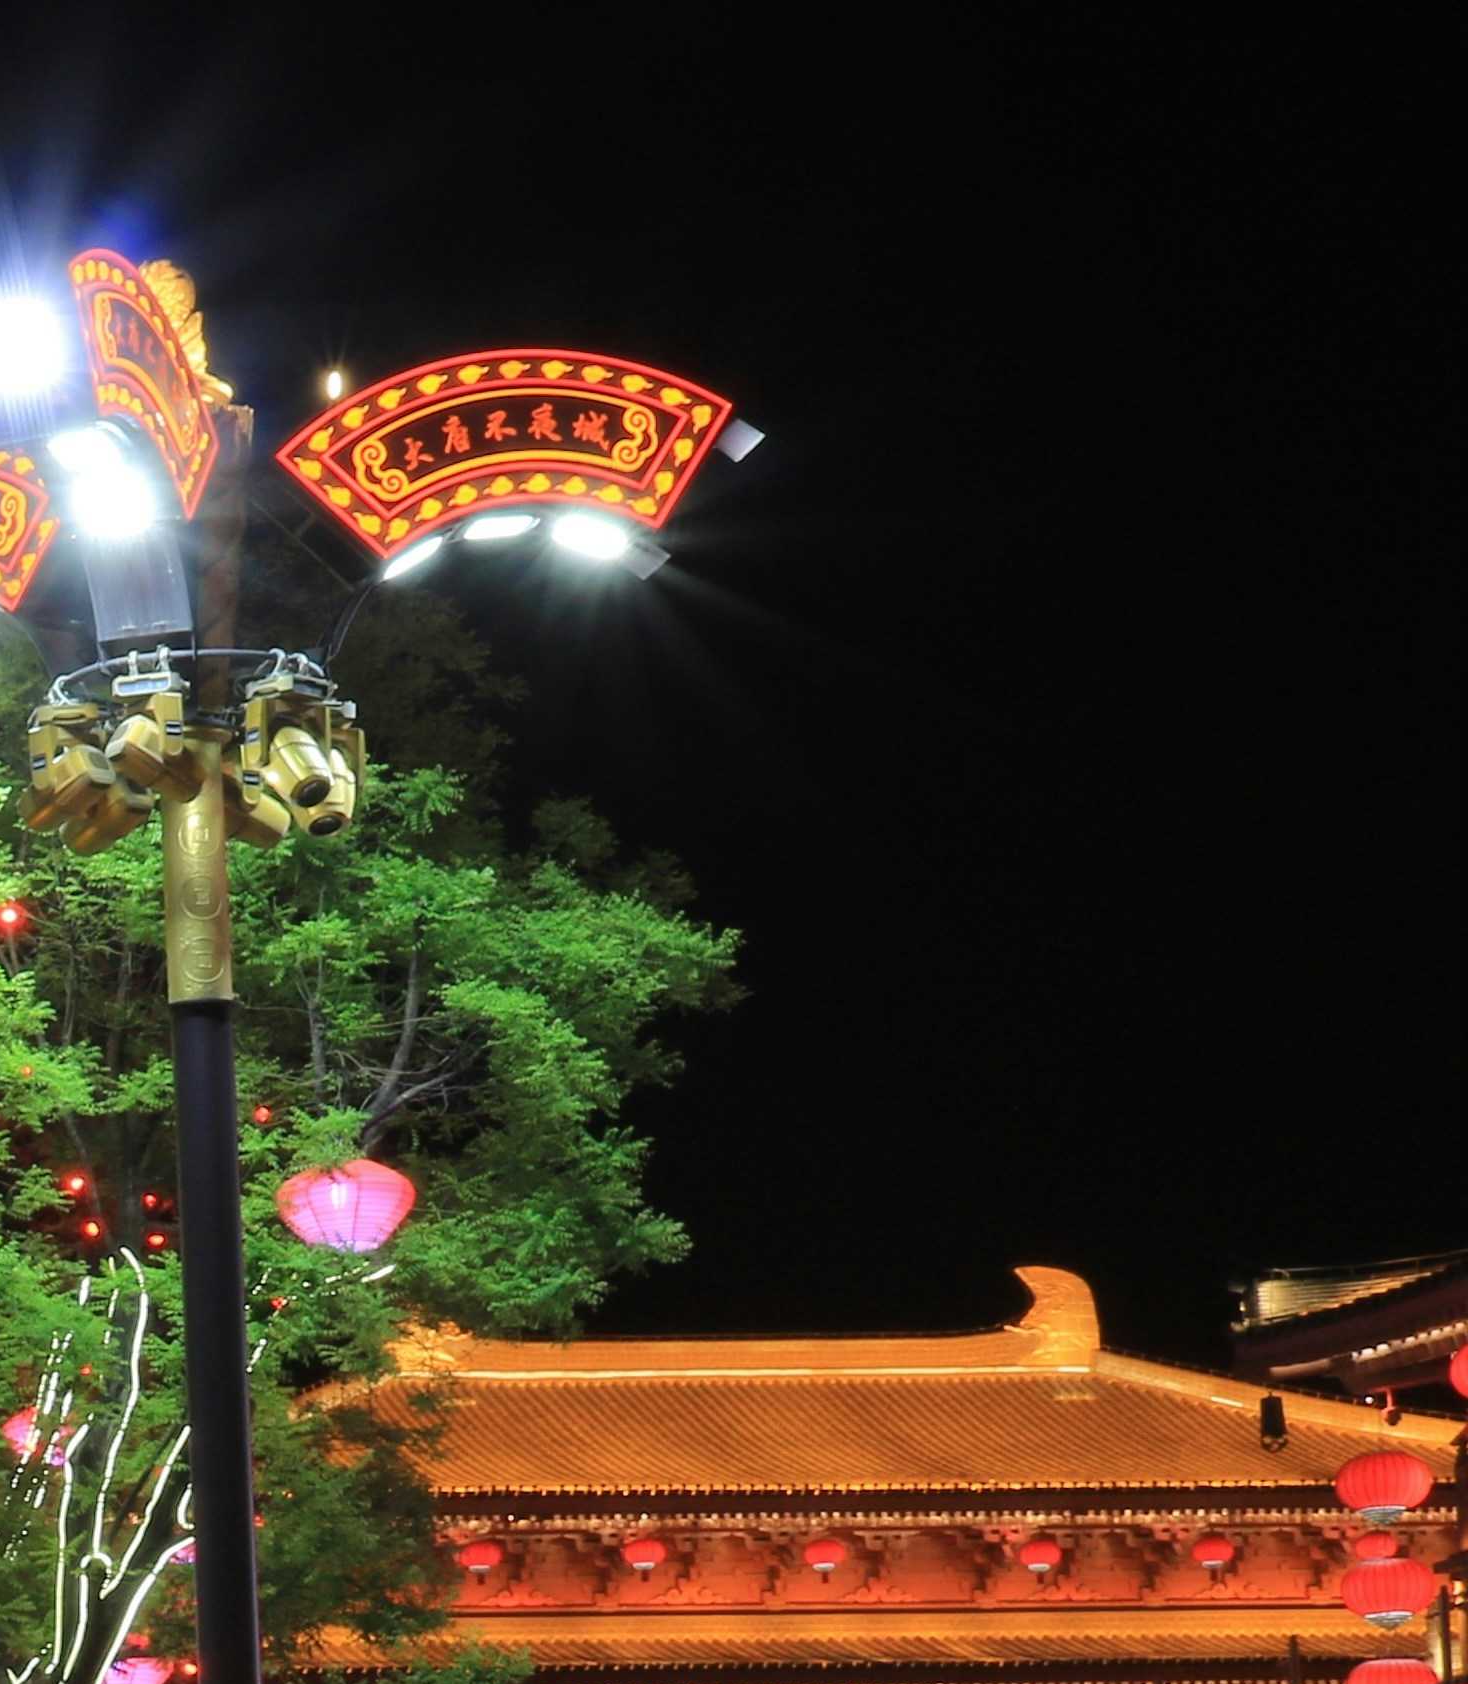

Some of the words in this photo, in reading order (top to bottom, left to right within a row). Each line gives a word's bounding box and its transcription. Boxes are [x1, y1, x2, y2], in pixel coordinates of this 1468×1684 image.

[404, 403, 610, 470] 大唐不夜城
